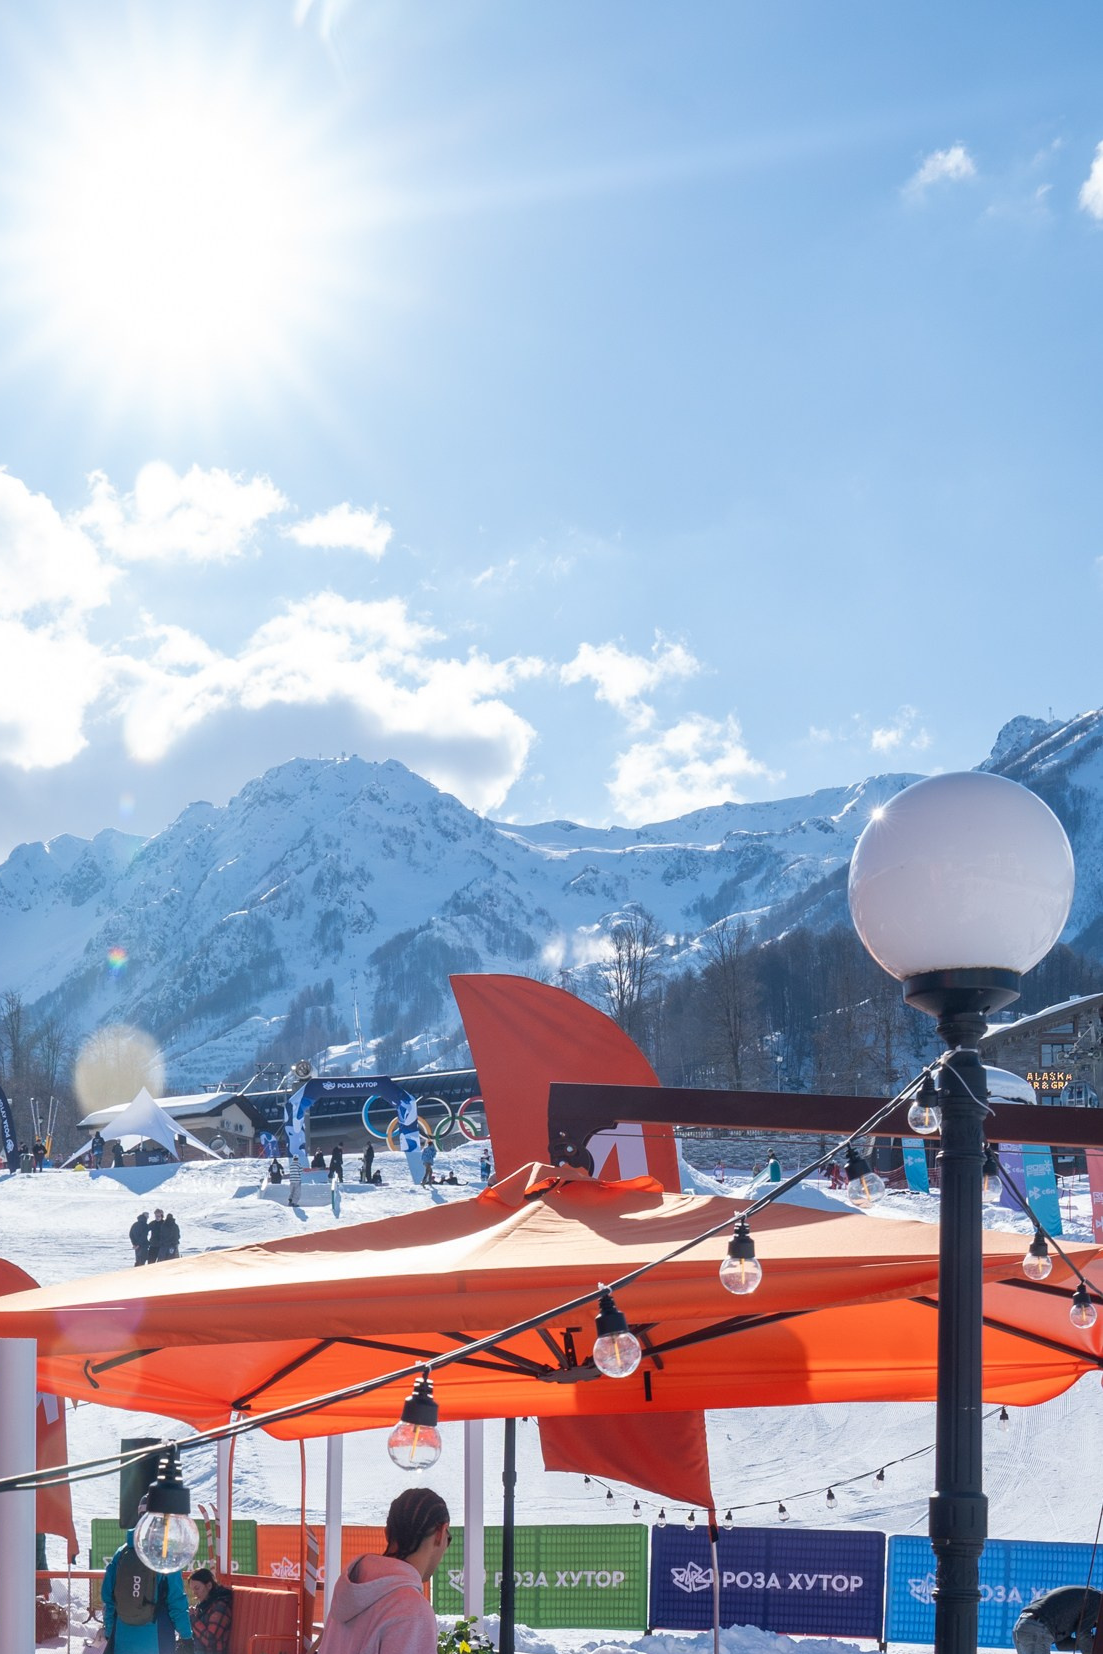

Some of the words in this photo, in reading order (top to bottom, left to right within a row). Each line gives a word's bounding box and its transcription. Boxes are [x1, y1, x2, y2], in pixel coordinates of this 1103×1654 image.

[1026, 1072, 1073, 1081] ALASKA
[2, 1119, 11, 1138] РОЗА
[554, 1570, 625, 1588] ХУТОР
[722, 1571, 781, 1589] РОЗА
[787, 1572, 864, 1593] ХУТОР
[978, 1584, 1023, 1604] ОЗА
